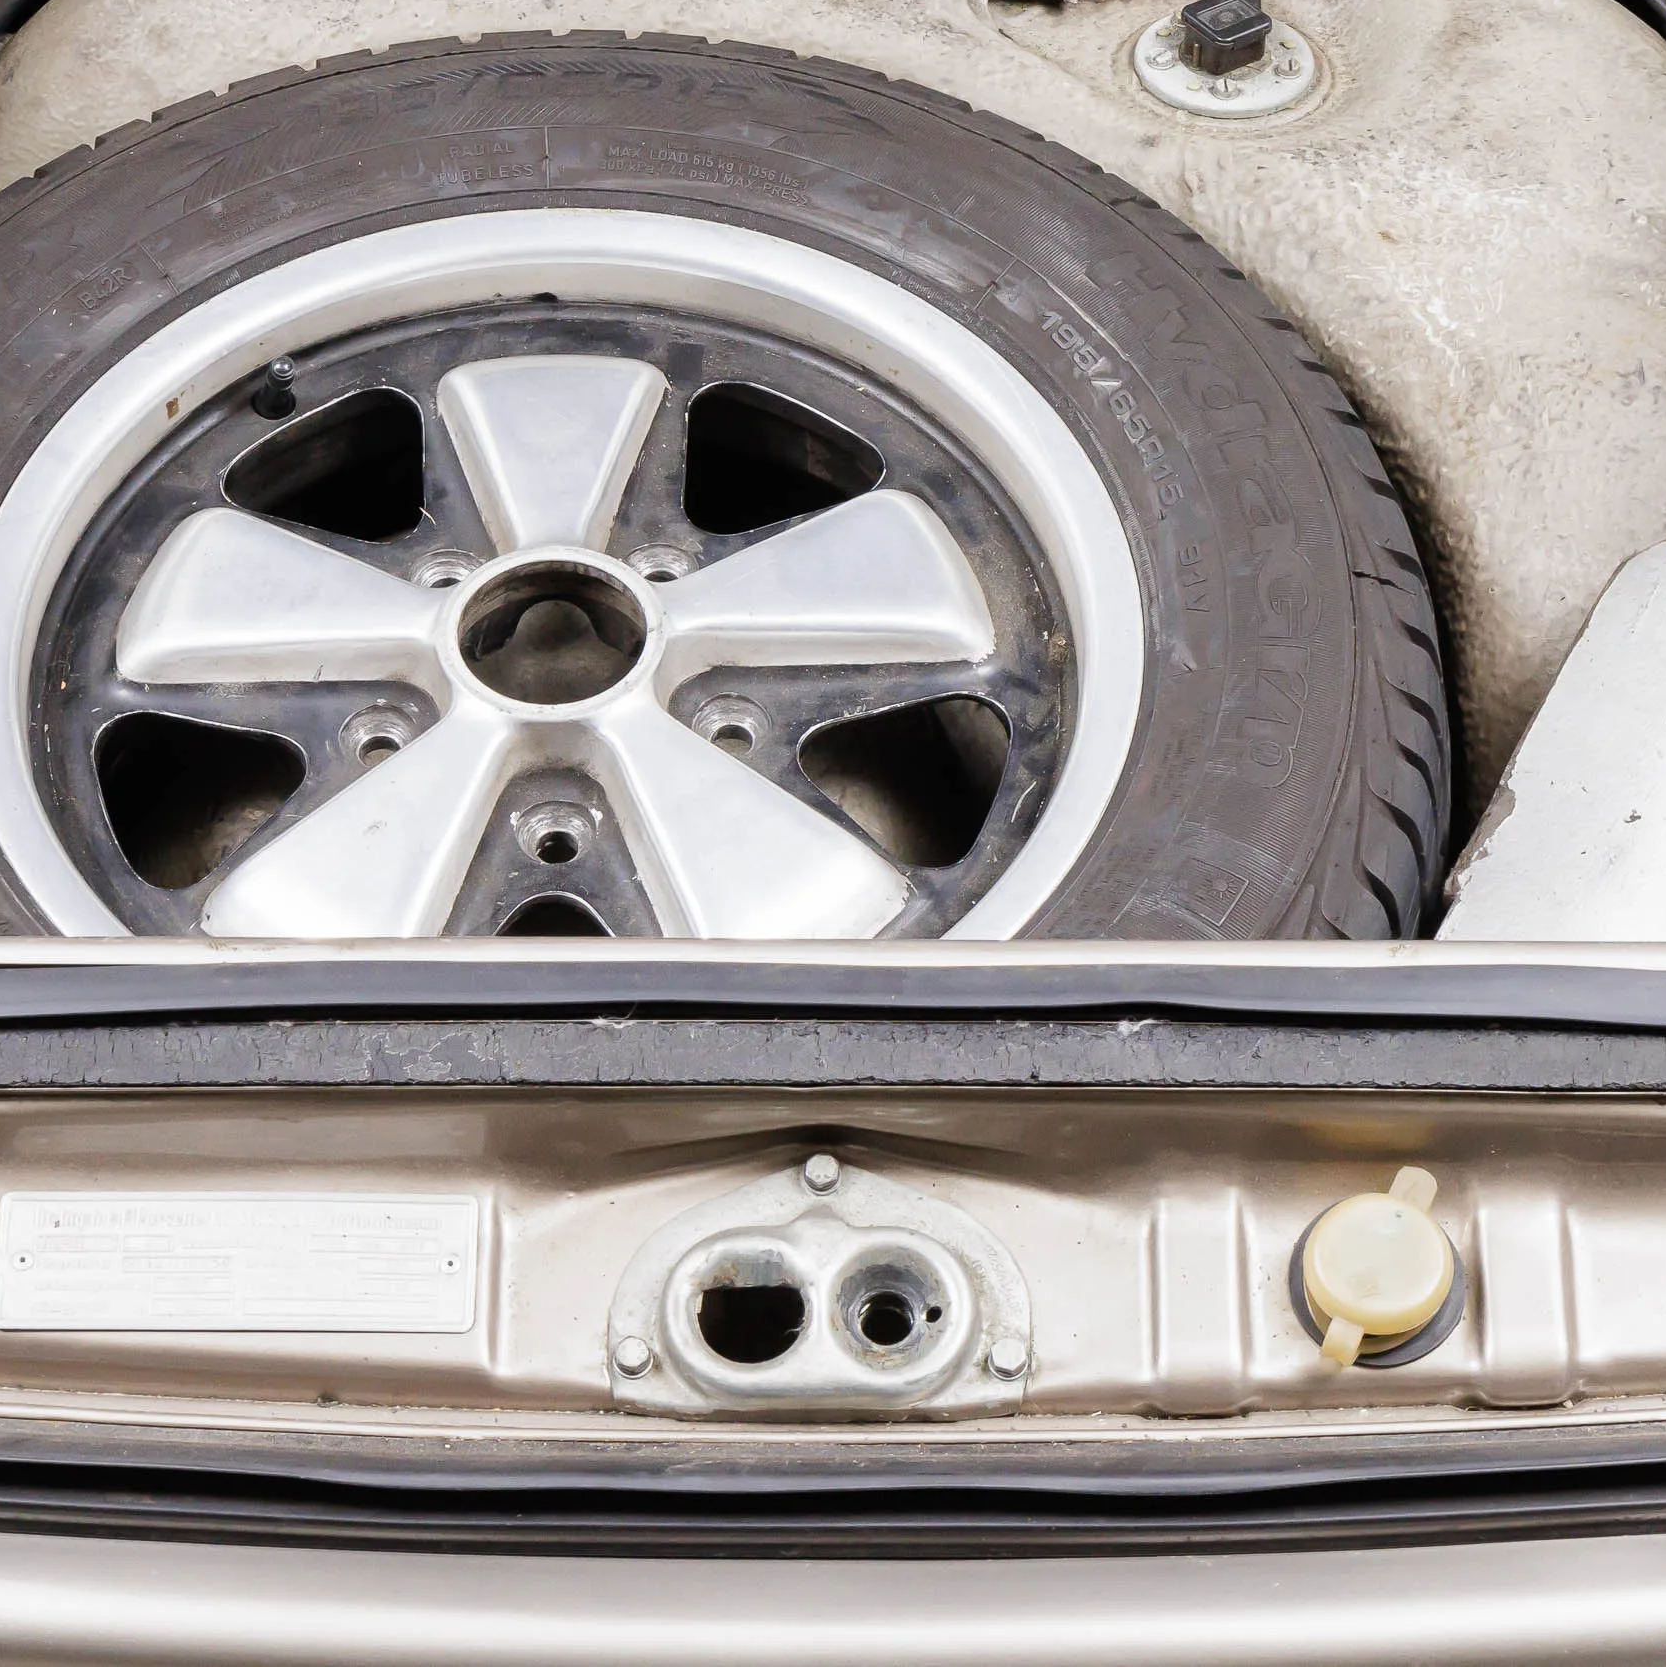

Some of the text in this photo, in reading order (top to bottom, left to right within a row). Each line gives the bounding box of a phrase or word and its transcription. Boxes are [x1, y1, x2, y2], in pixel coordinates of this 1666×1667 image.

[448, 140, 514, 159] RADIAL
[649, 148, 690, 165] LOAD
[692, 154, 715, 169] 615
[718, 158, 734, 174] kg
[437, 163, 536, 186] TUBELESS
[1039, 307, 1184, 510] 195/65R15
